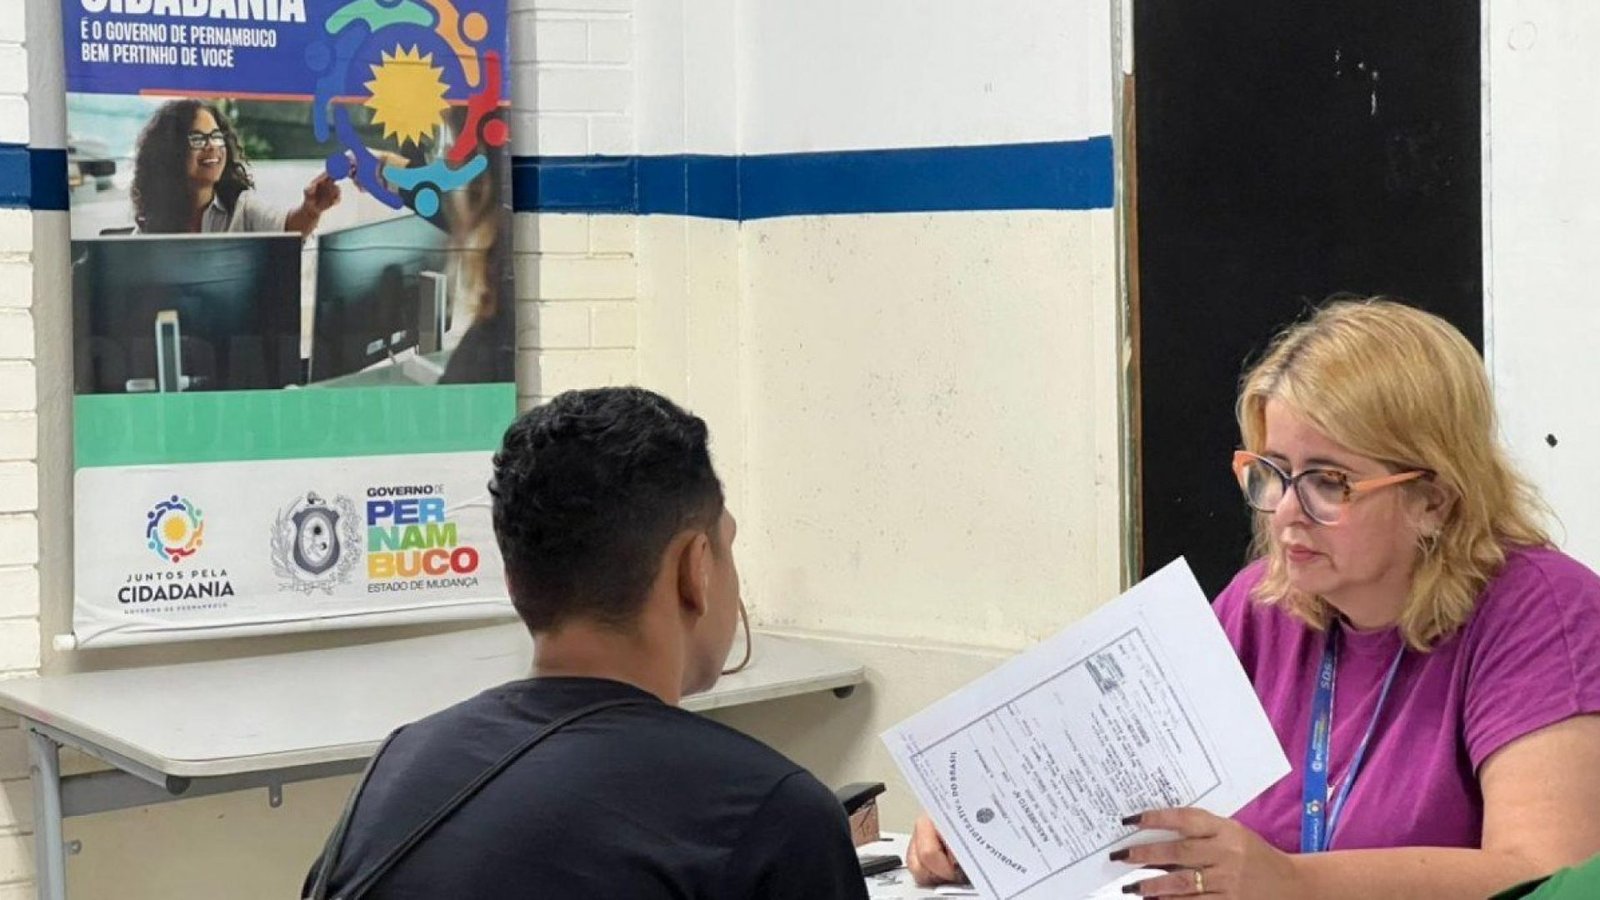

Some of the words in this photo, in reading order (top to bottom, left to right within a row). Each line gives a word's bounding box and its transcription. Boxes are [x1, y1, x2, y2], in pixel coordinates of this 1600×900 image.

[81, 17, 88, 40] É
[92, 21, 102, 40] O
[106, 21, 167, 42] GOVERNO
[170, 24, 187, 44] DE
[189, 25, 277, 48] PERNAMBUCO
[81, 42, 109, 62] BEM
[113, 44, 178, 65] PERTINHO
[181, 46, 198, 66] DE
[201, 46, 235, 68] VOCÊ
[367, 485, 434, 497] GOVERNO
[435, 484, 445, 494] DE
[367, 498, 445, 526] PER
[367, 522, 457, 552] NAM
[367, 546, 479, 578] BUCO
[126, 570, 184, 583] JUNTOS
[191, 568, 228, 579] PELA
[367, 582, 408, 593] ESTADO
[410, 580, 425, 591] DE
[426, 577, 479, 588] MUDANÇA
[117, 581, 235, 604] CIDADANIA
[950, 783, 959, 797] DO
